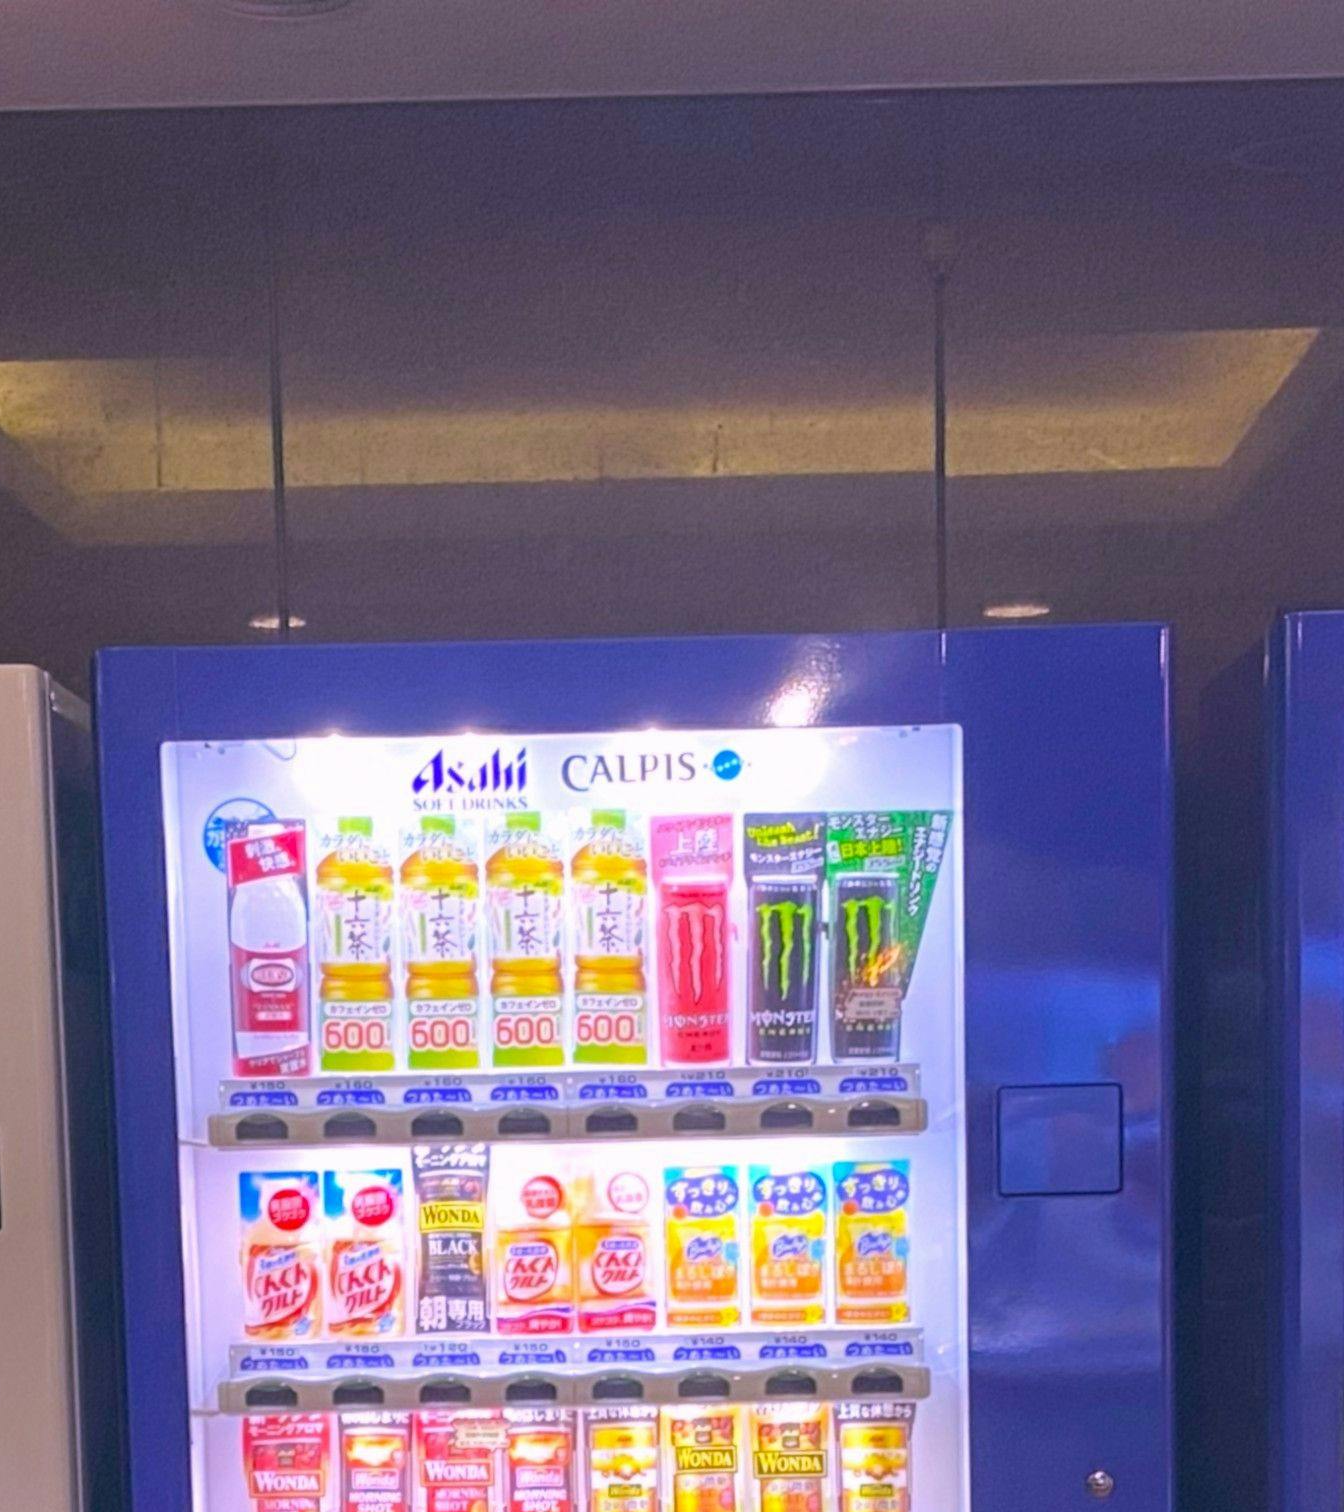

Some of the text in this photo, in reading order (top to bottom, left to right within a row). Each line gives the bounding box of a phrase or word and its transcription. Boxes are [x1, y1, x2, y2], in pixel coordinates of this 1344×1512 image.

[411, 748, 527, 794] Asahi
[561, 752, 696, 793] CALPIS
[413, 796, 529, 811] SOFT DRINKS
[344, 888, 374, 962] 十六茶
[429, 887, 458, 959] 十六茶
[513, 888, 543, 957] 十六茶
[595, 883, 623, 953] 十六茶
[324, 1020, 386, 1050] 600
[411, 1019, 471, 1049] 600
[494, 1016, 555, 1047] 600
[576, 1013, 636, 1042] 600
[422, 1204, 481, 1226] WONDA
[428, 1238, 479, 1255] BLACK
[425, 1460, 488, 1482] WONDA
[677, 1448, 734, 1468] WONDA
[758, 1452, 823, 1472] WONDA
[254, 1473, 320, 1493] WONDA
